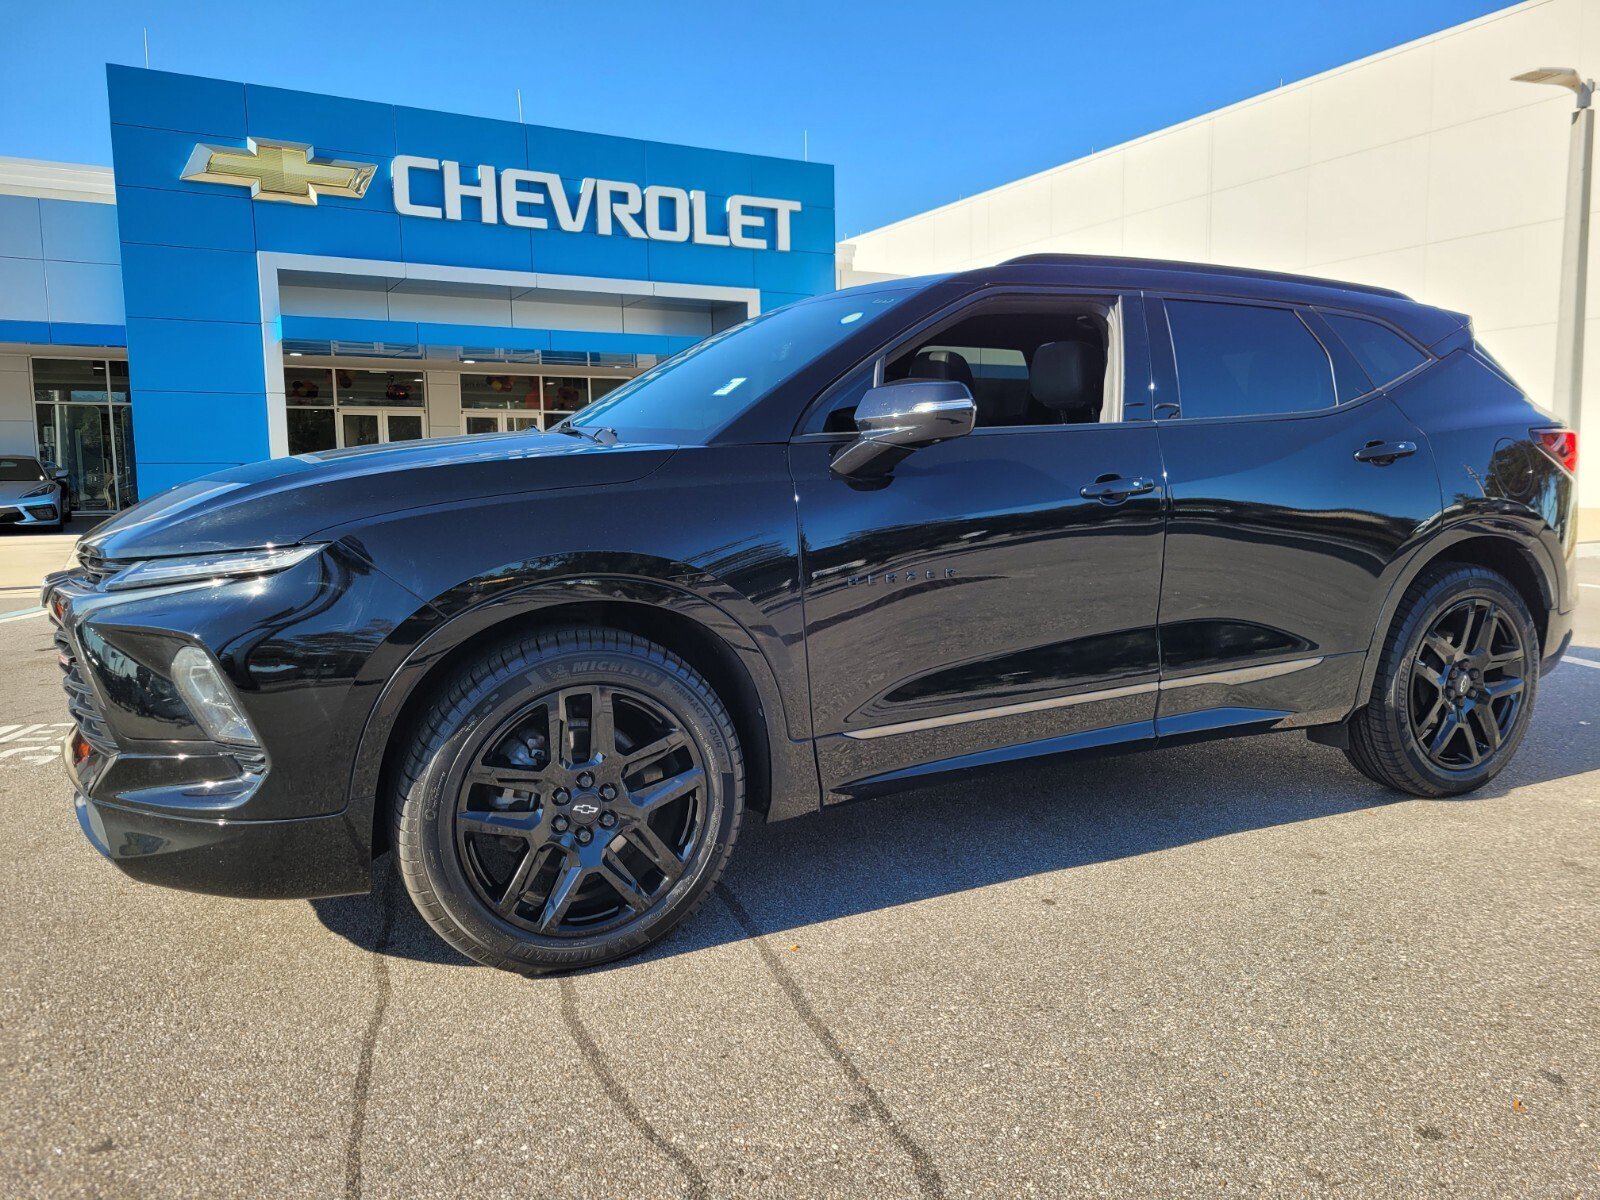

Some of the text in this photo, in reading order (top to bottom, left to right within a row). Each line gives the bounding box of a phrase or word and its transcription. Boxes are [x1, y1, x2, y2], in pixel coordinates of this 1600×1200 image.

[391, 155, 802, 251] CHEVROLET
[572, 661, 660, 684] MICHELIN
[671, 684, 708, 719] PRIMACY
[705, 721, 723, 748] TOUR
